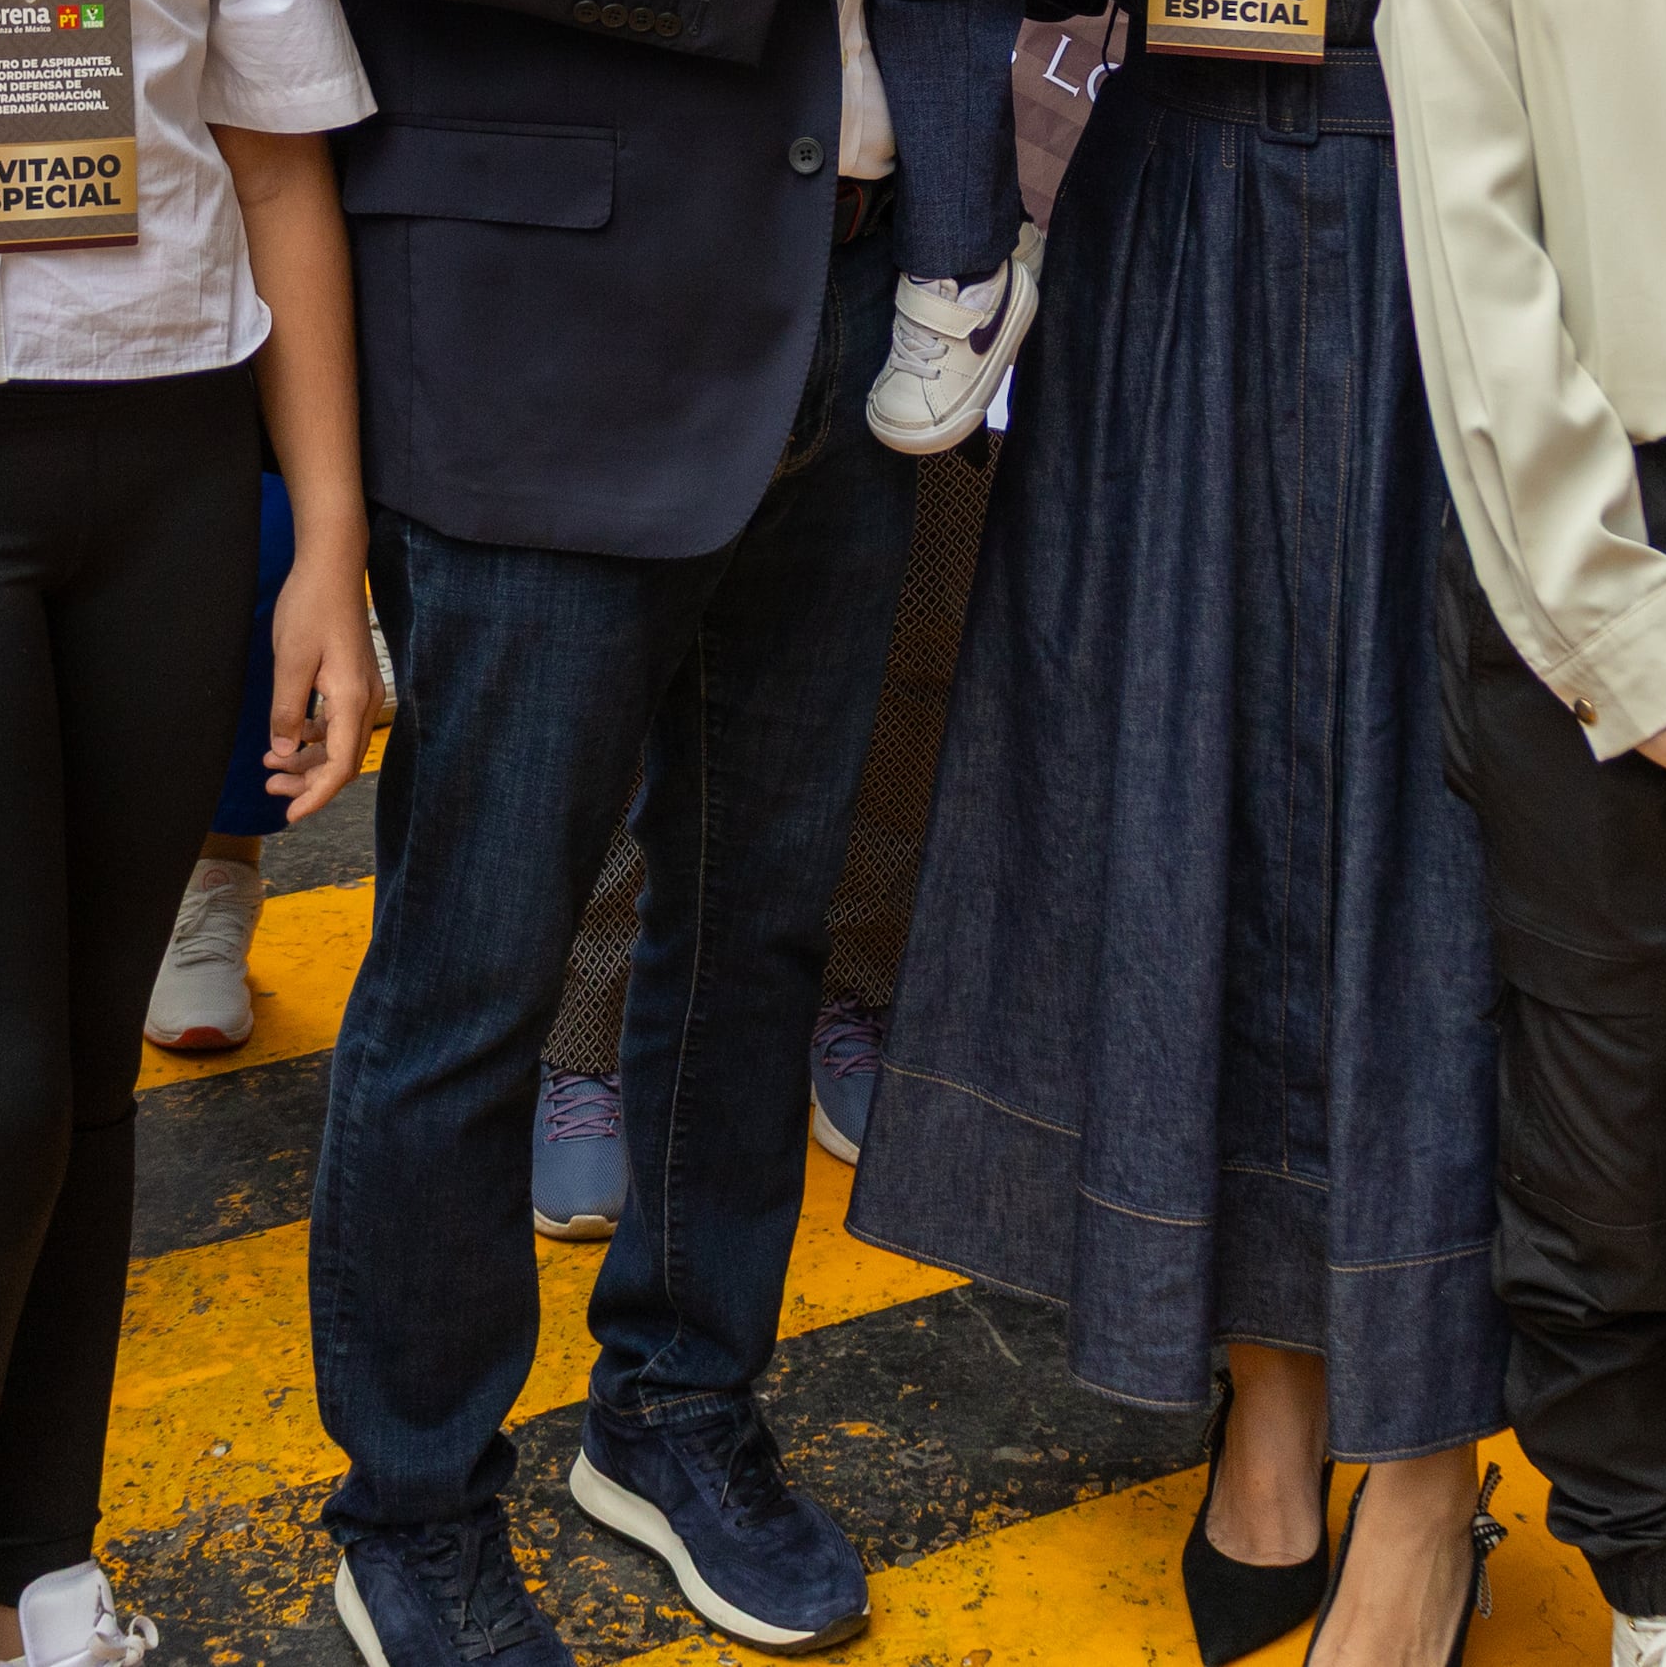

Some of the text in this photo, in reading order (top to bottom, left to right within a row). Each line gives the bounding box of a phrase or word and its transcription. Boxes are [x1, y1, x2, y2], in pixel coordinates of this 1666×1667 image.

[59, 14, 78, 28] PT
[14, 26, 23, 34] de
[25, 25, 51, 33] México
[22, 59, 38, 69] DE
[40, 56, 112, 68] ASPIRANTES
[74, 67, 123, 78] ESTATAL
[10, 79, 63, 91] DEFENSA
[66, 79, 82, 89] DE
[49, 101, 109, 112] NACIONAL
